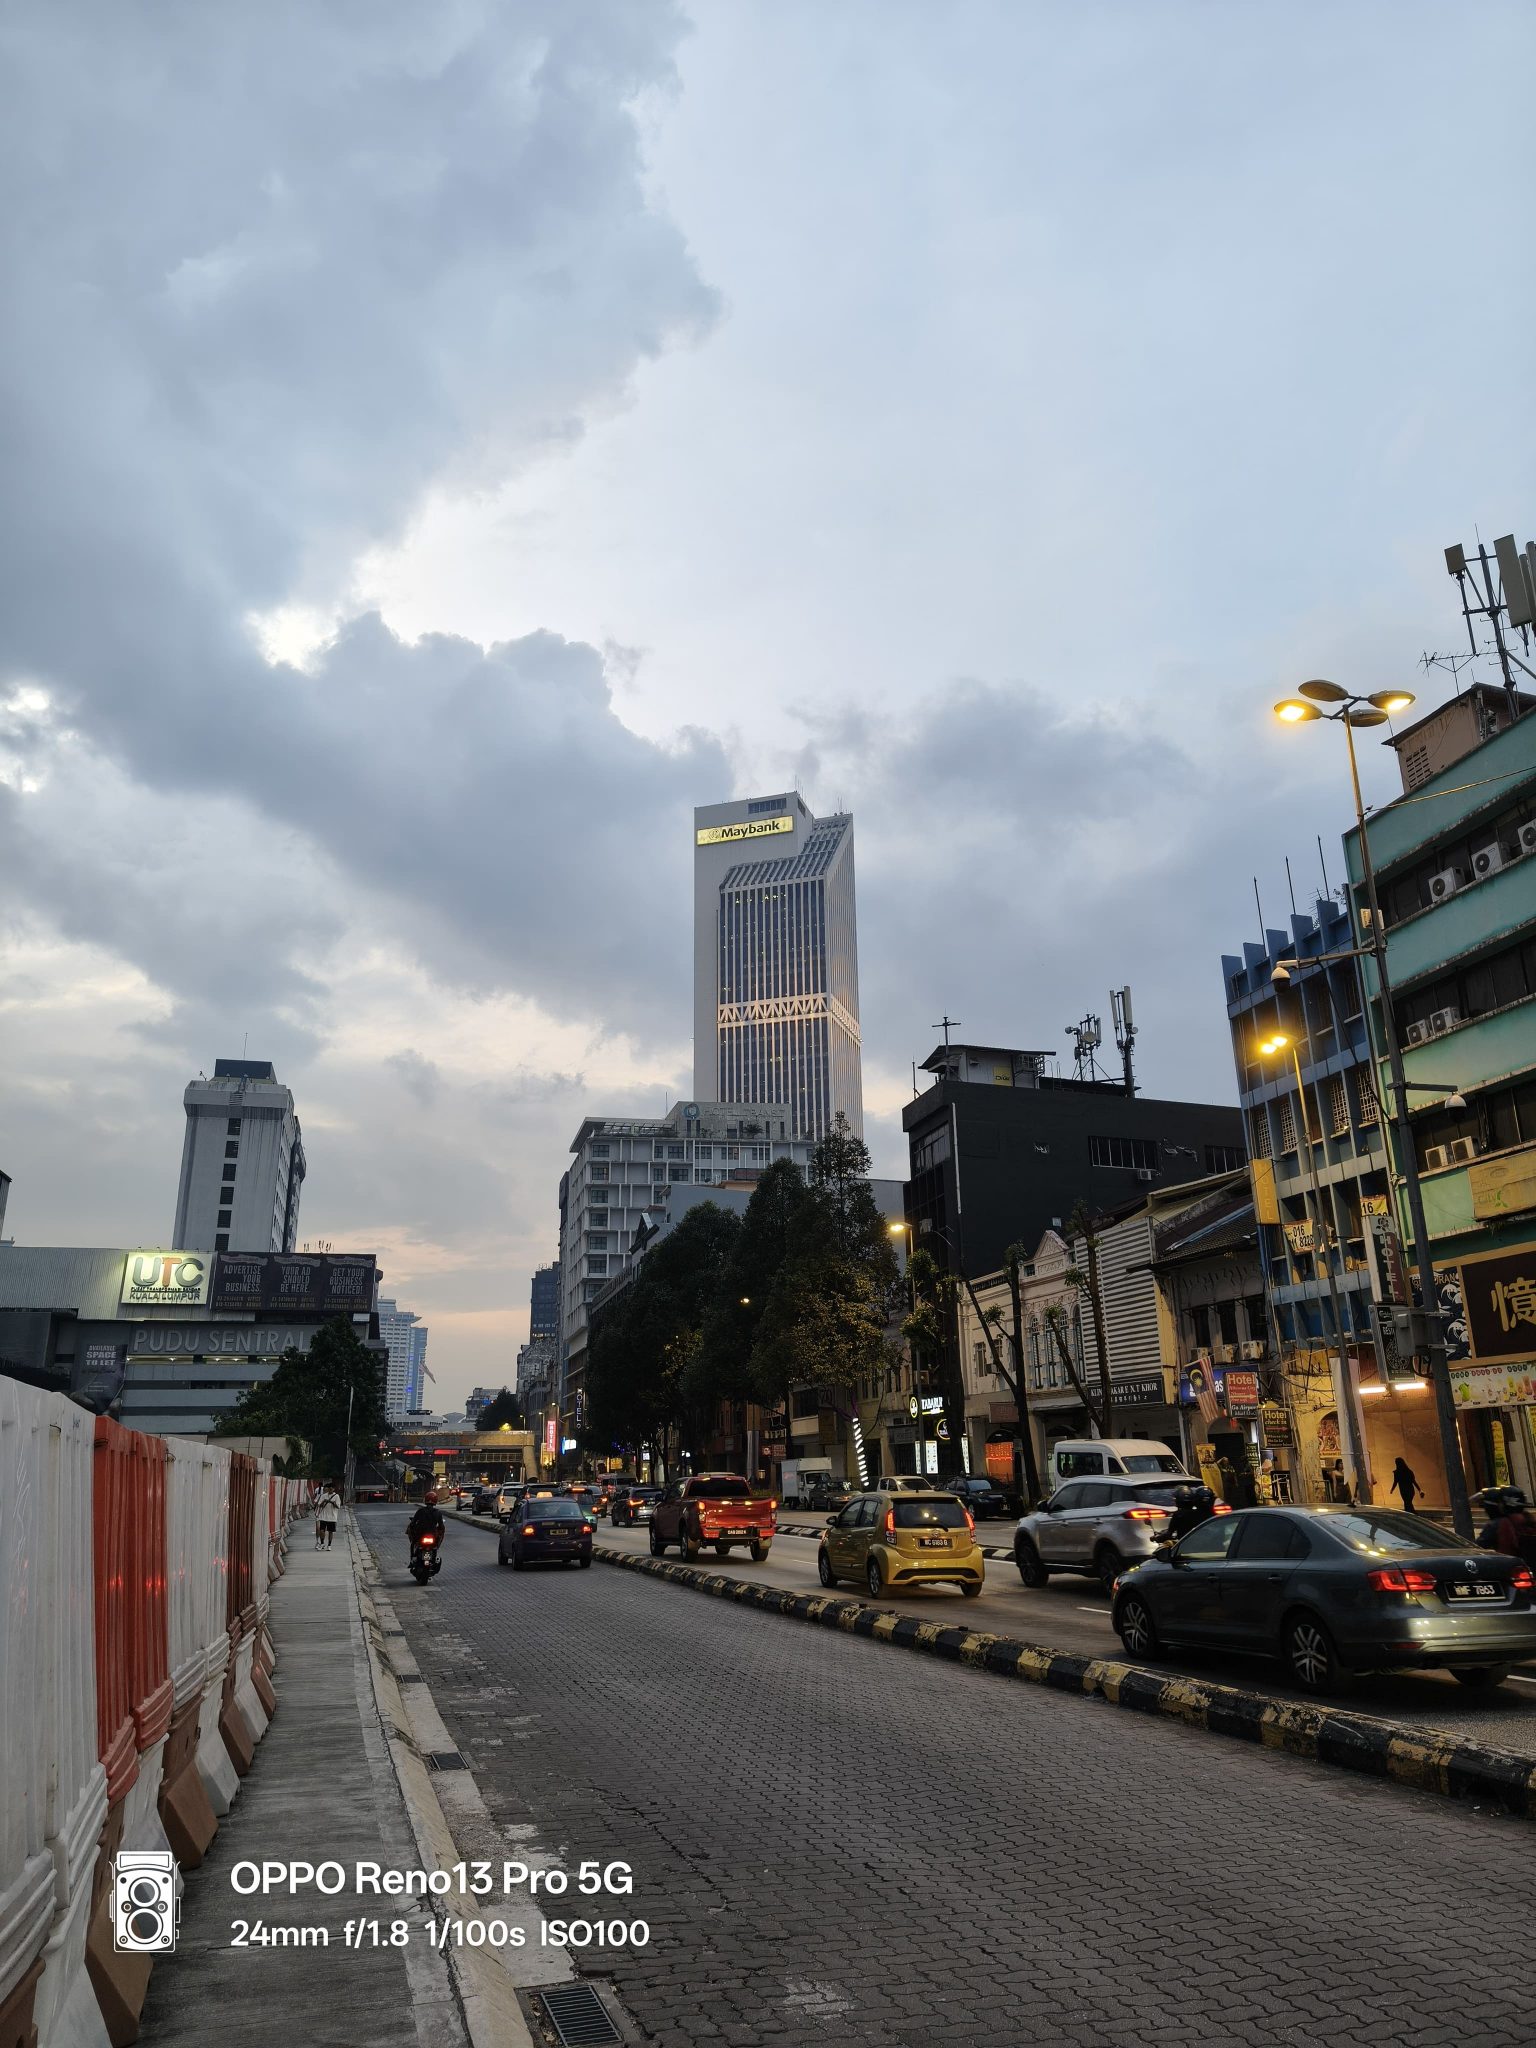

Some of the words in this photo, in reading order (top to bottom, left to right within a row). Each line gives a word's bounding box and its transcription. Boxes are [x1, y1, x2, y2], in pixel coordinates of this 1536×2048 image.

[721, 821, 780, 839] Maybank
[223, 1264, 262, 1275] ADVERTISE
[1379, 1235, 1399, 1295] HOTEL
[132, 1257, 204, 1288] UTC
[280, 1266, 299, 1276] YOUR
[301, 1266, 311, 1276] AD
[332, 1267, 346, 1277] GET
[347, 1267, 365, 1277] YOUR
[242, 1274, 261, 1284] YOUR
[283, 1274, 310, 1284] SHOULD
[329, 1276, 363, 1286] BUSINESS
[280, 1283, 290, 1293] BE
[129, 1292, 159, 1301] KUALA
[161, 1292, 201, 1301] LUMPUR
[133, 1329, 200, 1353] PUDU
[207, 1329, 311, 1353] SENTRAL
[86, 1351, 117, 1359] SPACE
[1227, 1374, 1256, 1385] Hotel
[1141, 1382, 1158, 1392] KHOR
[1264, 1411, 1287, 1419] Hotel
